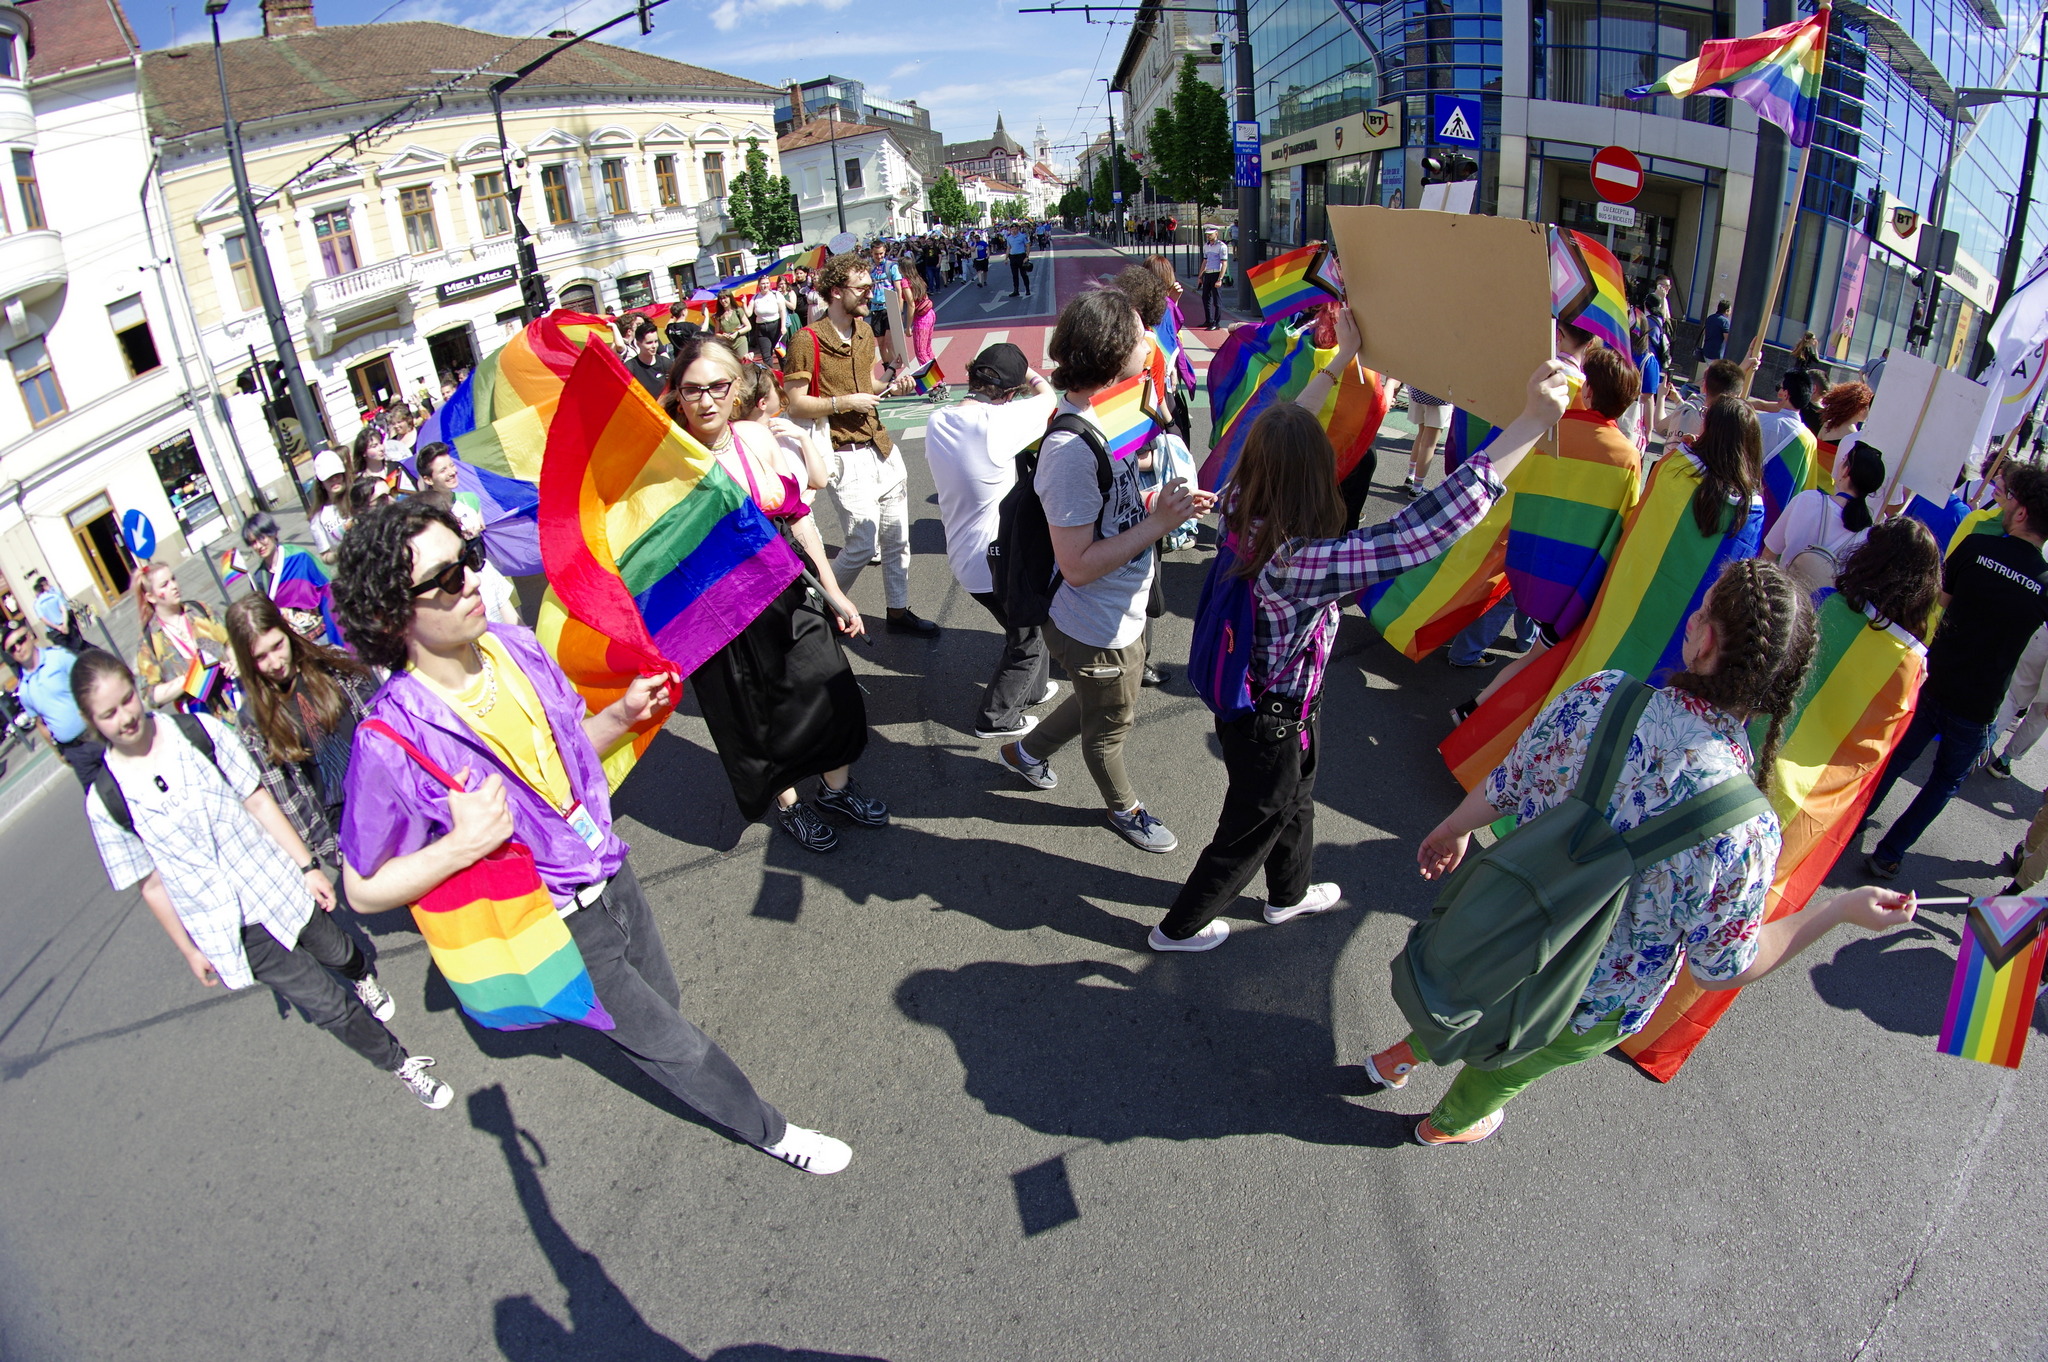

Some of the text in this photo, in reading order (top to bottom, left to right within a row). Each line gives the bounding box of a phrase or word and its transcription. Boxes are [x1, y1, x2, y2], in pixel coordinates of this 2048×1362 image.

[1369, 115, 1383, 125] BT
[1896, 213, 1912, 226] BT
[444, 279, 475, 294] MELI
[478, 269, 512, 283] MELO
[988, 546, 1001, 556] EE
[1976, 555, 2042, 595] INSTRUKTØR
